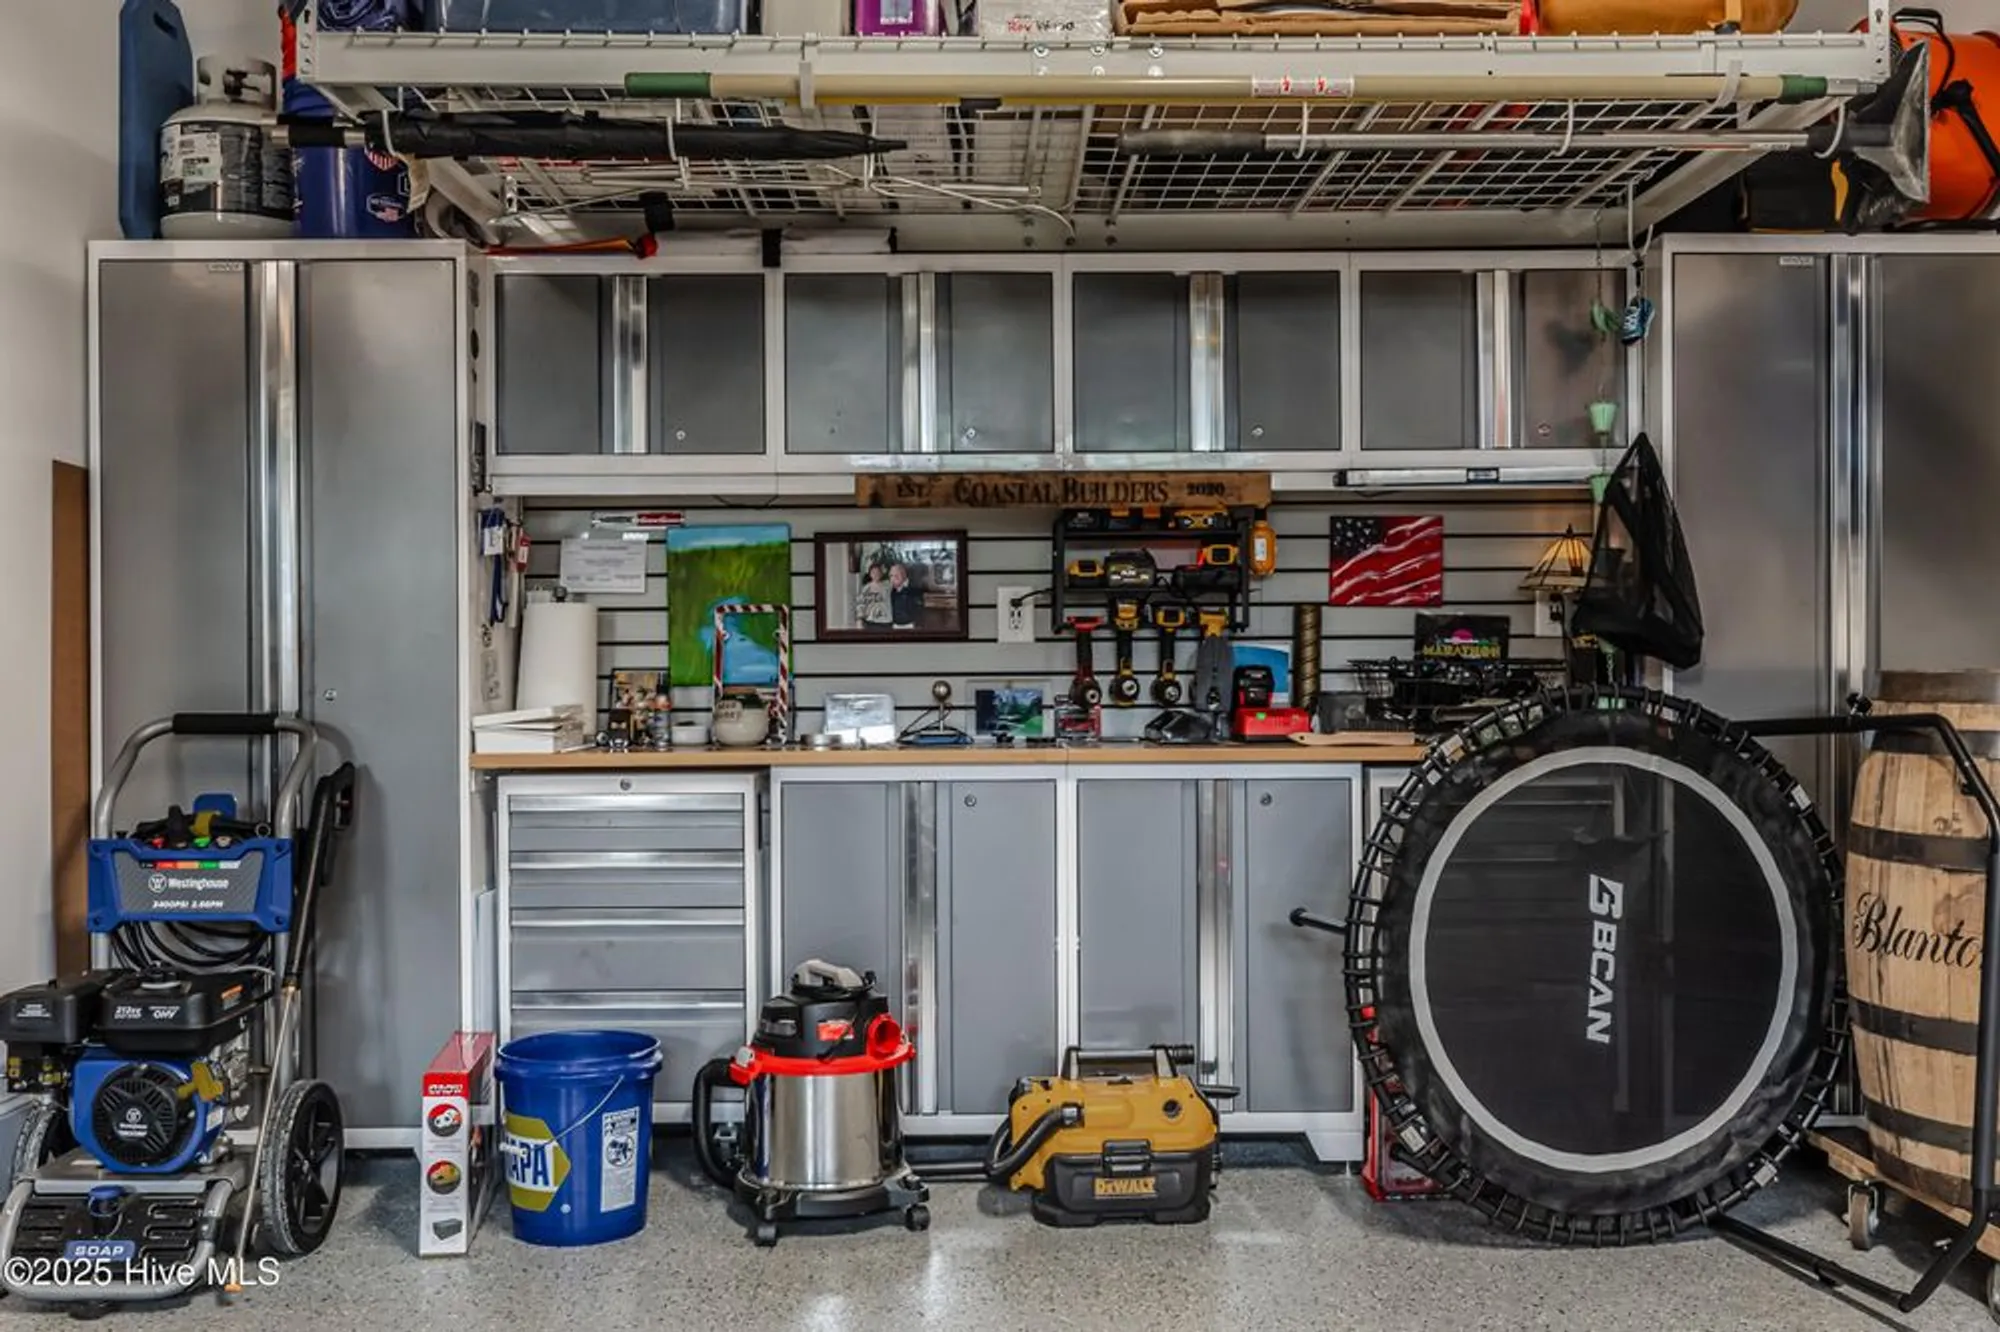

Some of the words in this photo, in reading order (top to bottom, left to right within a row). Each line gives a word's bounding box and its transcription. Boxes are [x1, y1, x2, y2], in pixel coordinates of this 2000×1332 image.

[1064, 477, 1169, 504] BUILDERS
[168, 877, 229, 890] Westinghouse
[73, 1243, 125, 1257] SOAP
